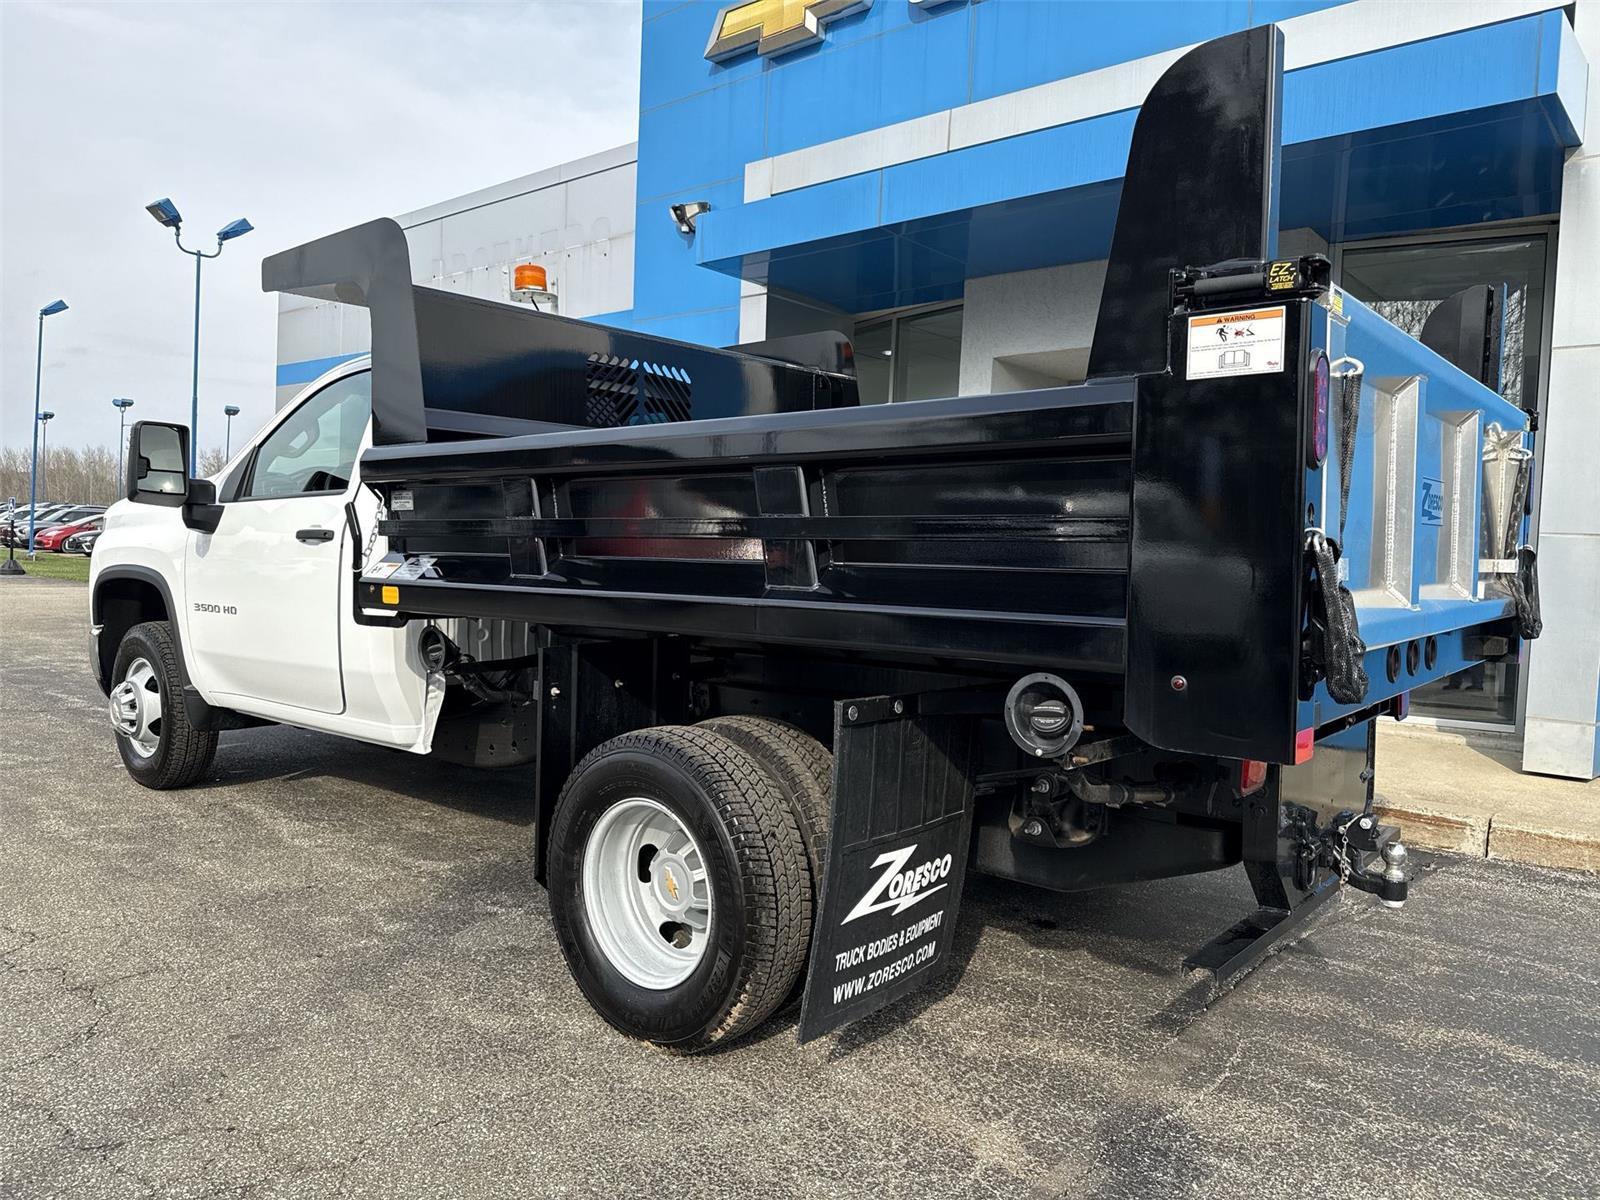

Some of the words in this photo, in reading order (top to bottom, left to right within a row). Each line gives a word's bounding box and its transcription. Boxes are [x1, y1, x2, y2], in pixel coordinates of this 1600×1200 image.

[1270, 262, 1296, 276] EZ-
[1269, 275, 1296, 284] LATCH
[1224, 313, 1256, 322] WARNING
[194, 603, 220, 613] 3500
[223, 605, 237, 615] HD
[840, 844, 952, 926] ZORESCO
[835, 945, 866, 972] TRUCK
[867, 934, 899, 961] BODIES
[899, 930, 905, 947] &
[905, 911, 944, 943] EQUIPMENT
[833, 941, 936, 1004] WWW.ZORESCO.COM
